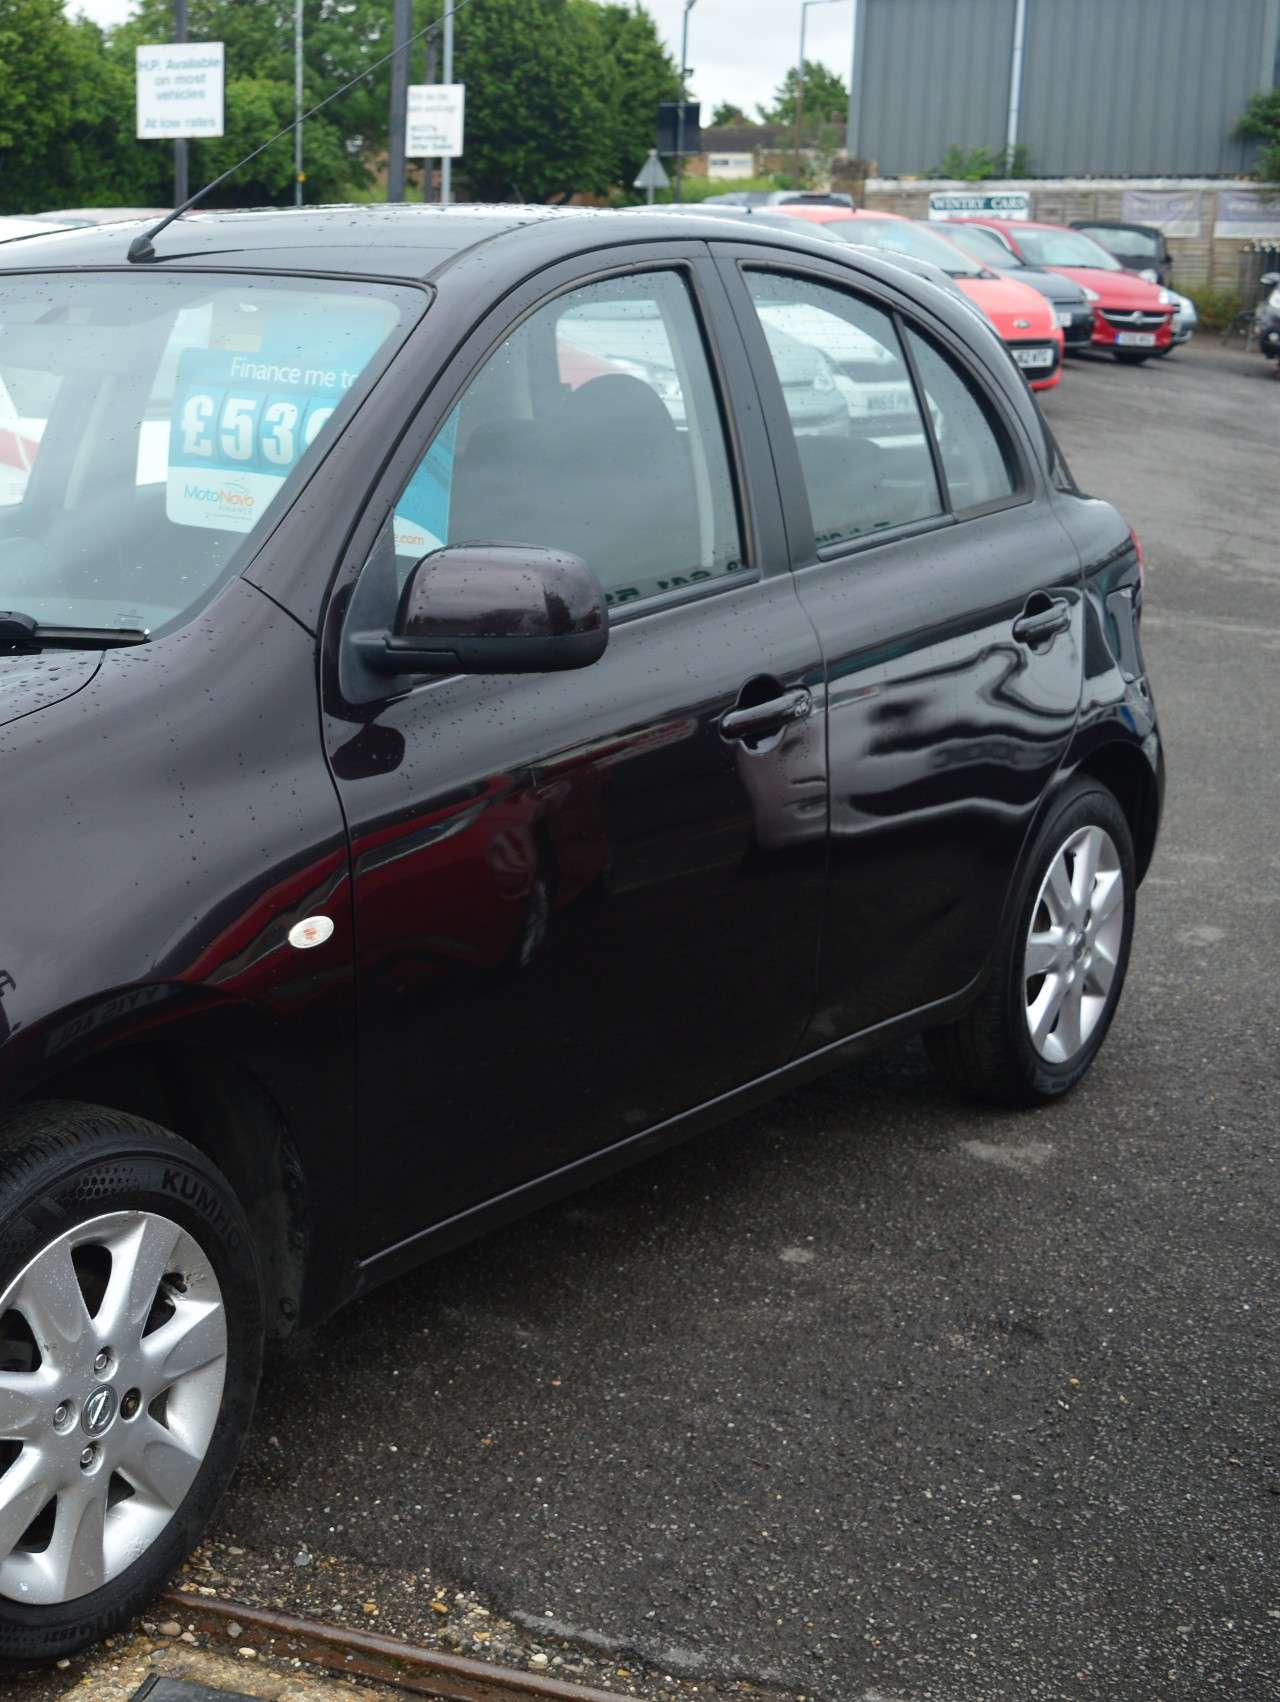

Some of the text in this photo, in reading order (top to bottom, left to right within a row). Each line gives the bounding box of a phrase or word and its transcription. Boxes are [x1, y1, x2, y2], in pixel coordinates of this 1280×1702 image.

[154, 74, 207, 87] on most
[156, 88, 206, 100] vehicles
[185, 117, 217, 128] rates
[229, 357, 300, 385] Finance
[304, 370, 337, 388] me
[184, 484, 254, 506] MotoNovo
[161, 1167, 242, 1250] KUMHO
